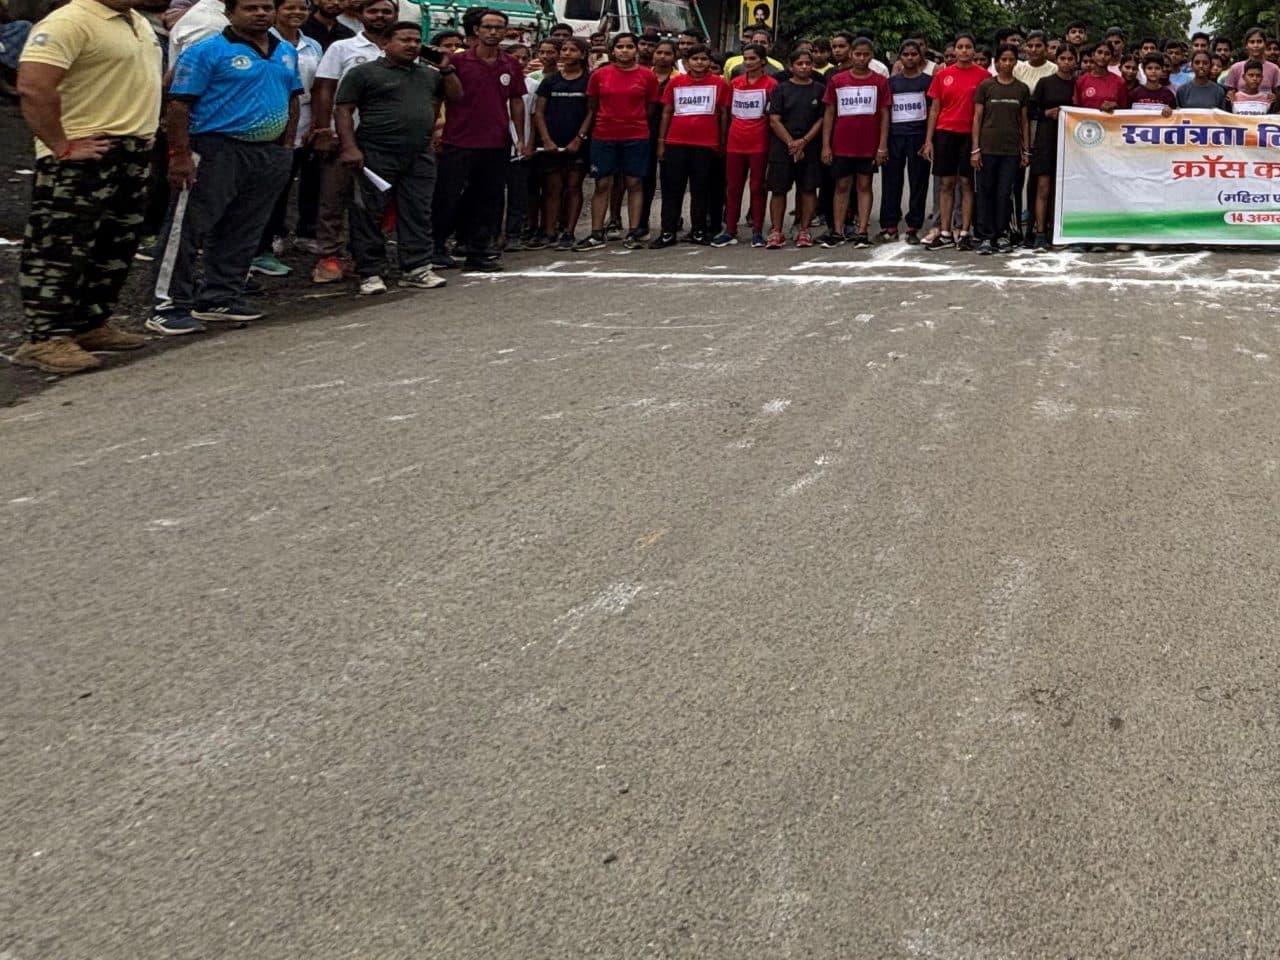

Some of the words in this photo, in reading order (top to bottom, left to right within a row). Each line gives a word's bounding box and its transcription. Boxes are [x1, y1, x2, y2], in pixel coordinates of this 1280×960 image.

[1121, 120, 1247, 146] स्वतंत्रता
[1172, 155, 1246, 181] क्रॉस
[1231, 213, 1243, 222] 14
